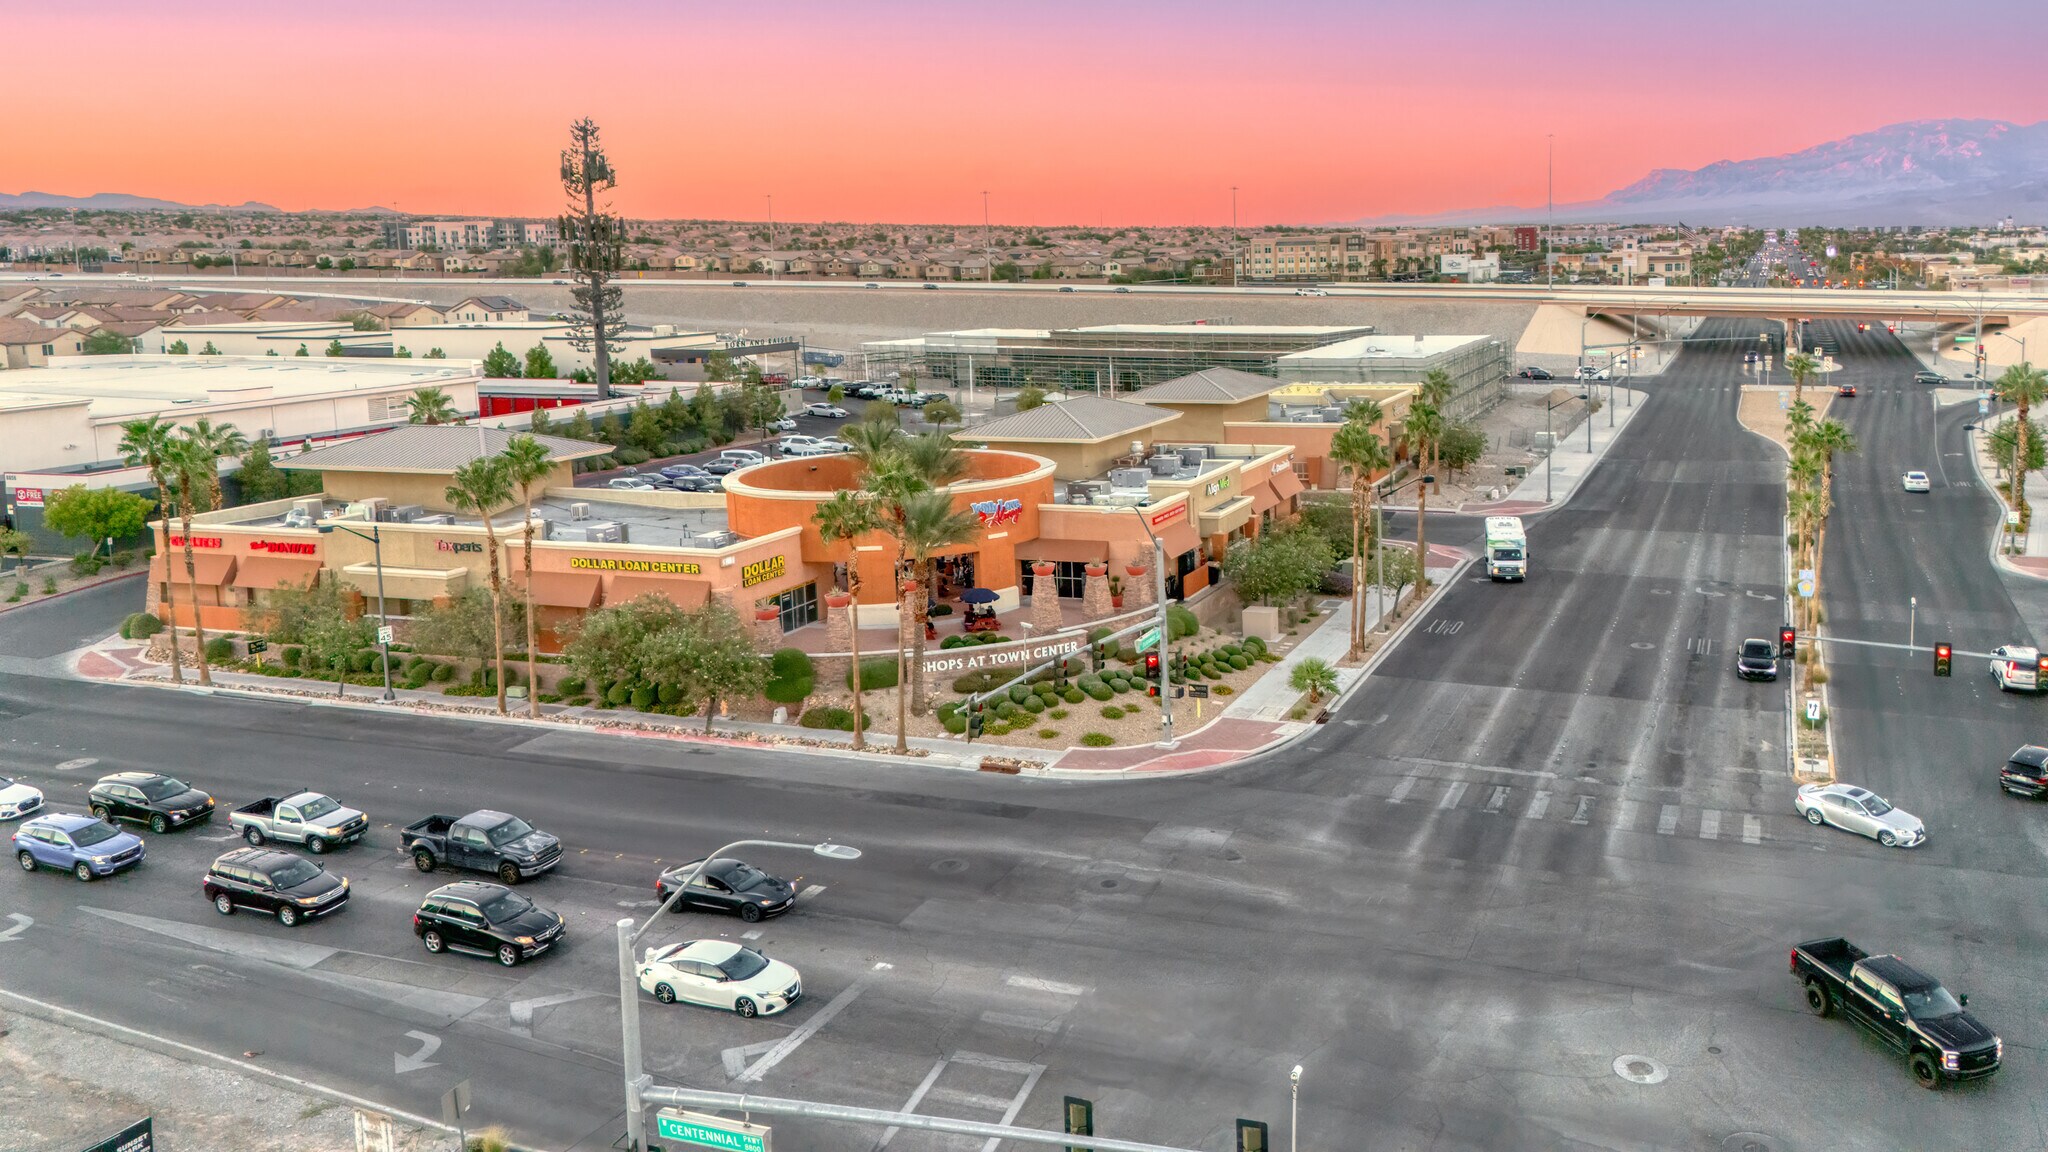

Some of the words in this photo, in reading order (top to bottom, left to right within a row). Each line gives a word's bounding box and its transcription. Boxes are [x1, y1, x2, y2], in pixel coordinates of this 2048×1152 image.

[26, 491, 42, 499] FREE
[171, 535, 222, 548] CLNERS
[267, 542, 316, 554] DONUTS
[571, 557, 617, 570] DOLLAR
[618, 560, 650, 572] LOAN
[651, 562, 700, 574] CENTER
[742, 555, 785, 579] DOLLAR
[743, 576, 761, 588] LOAN
[762, 568, 785, 581] CENTER
[922, 658, 963, 673] SHOPS
[968, 655, 985, 668] AT
[990, 650, 1030, 665] TOWN
[1033, 641, 1078, 659] CENTER
[116, 1132, 149, 1152] SUNSET
[669, 1124, 741, 1147] CENTENNIAL
[743, 1135, 761, 1145] PKWY
